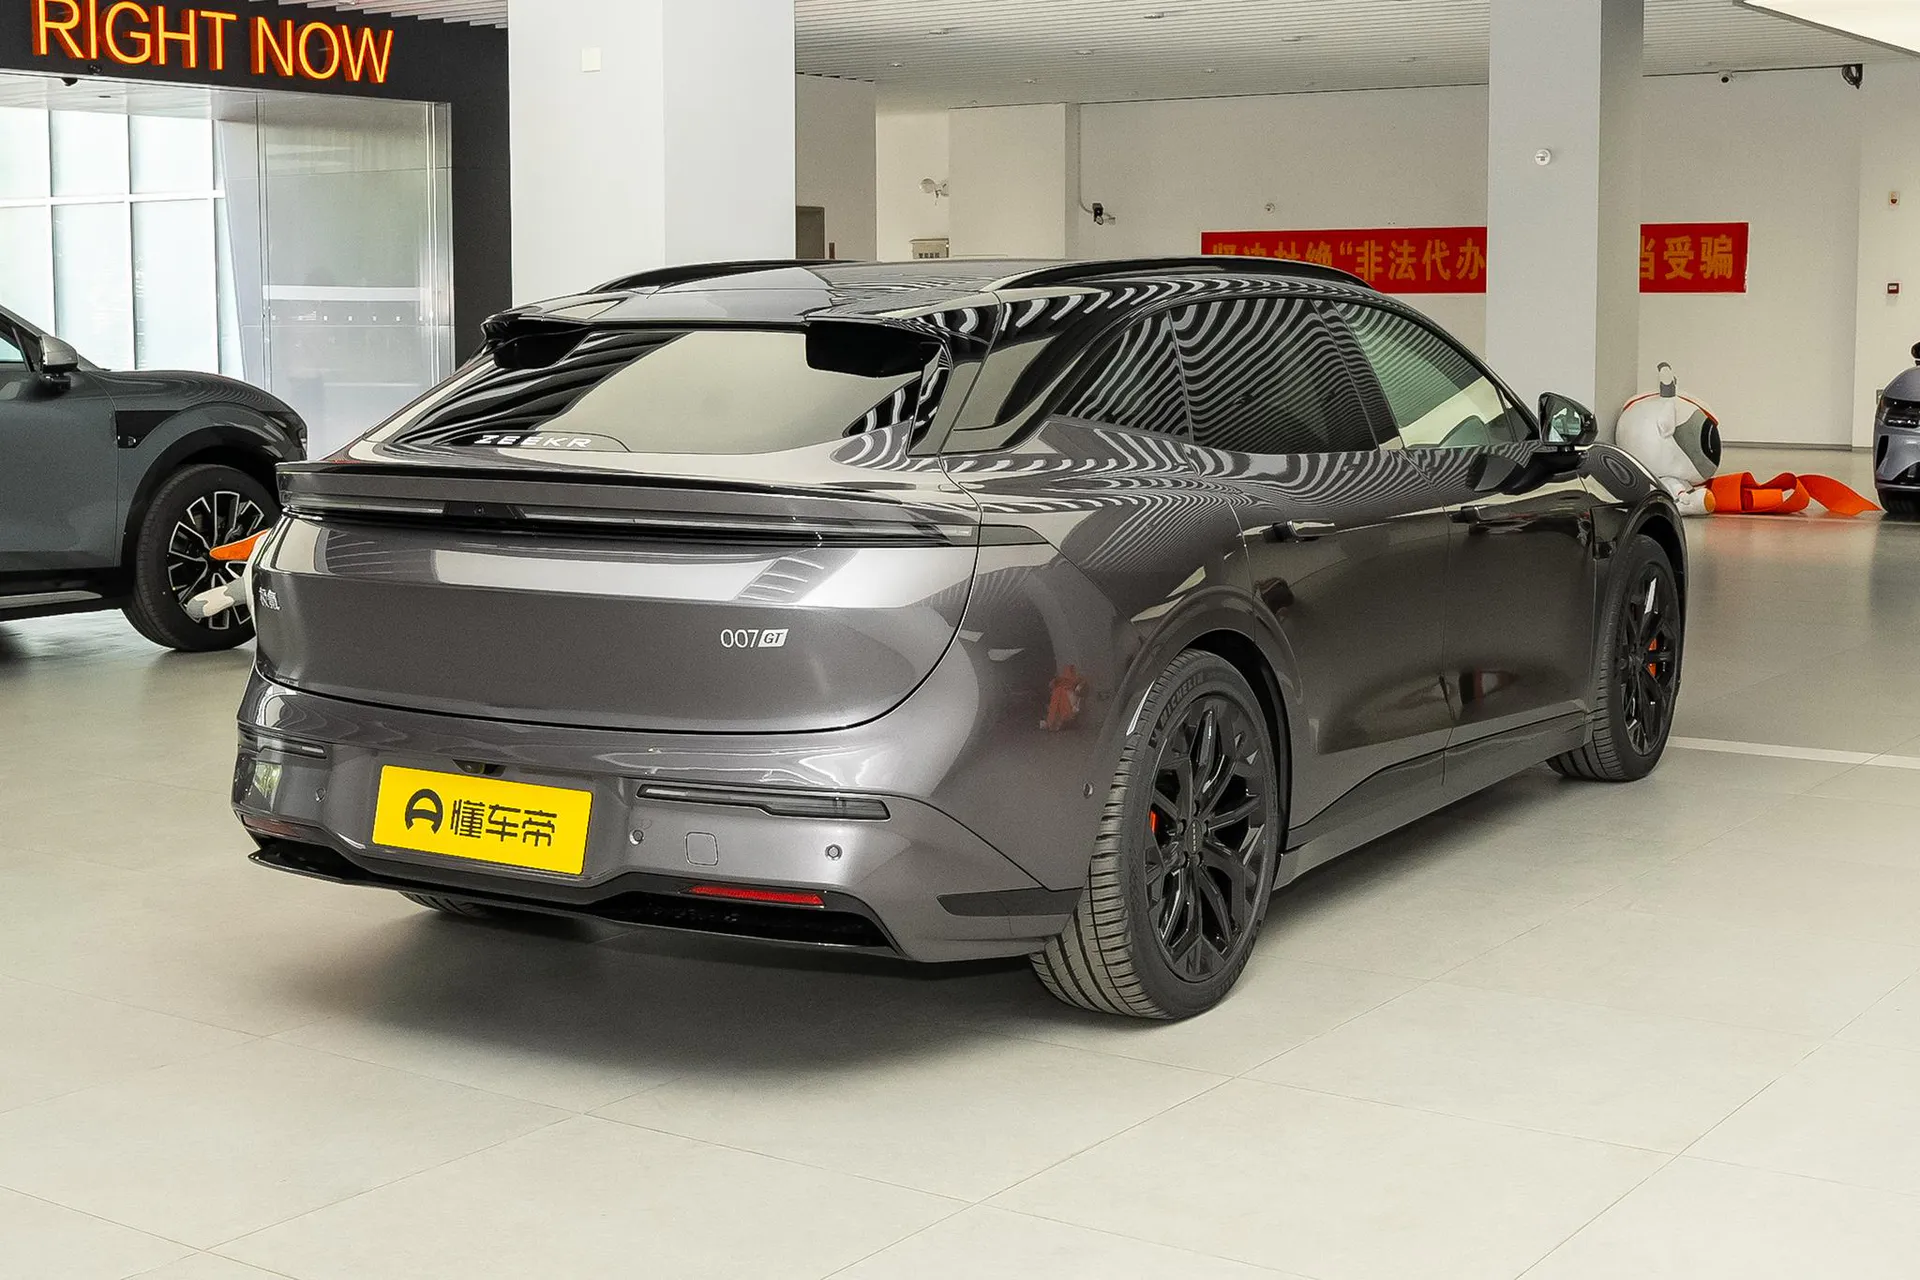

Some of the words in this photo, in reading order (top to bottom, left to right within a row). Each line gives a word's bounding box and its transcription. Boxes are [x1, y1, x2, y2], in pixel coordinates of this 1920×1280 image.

[32, 0, 237, 70] RIGHT
[251, 16, 394, 83] NOW
[474, 434, 592, 448] ZEEKR
[720, 628, 760, 648] 007
[761, 631, 786, 645] GT
[450, 799, 558, 847] 懂车帝
